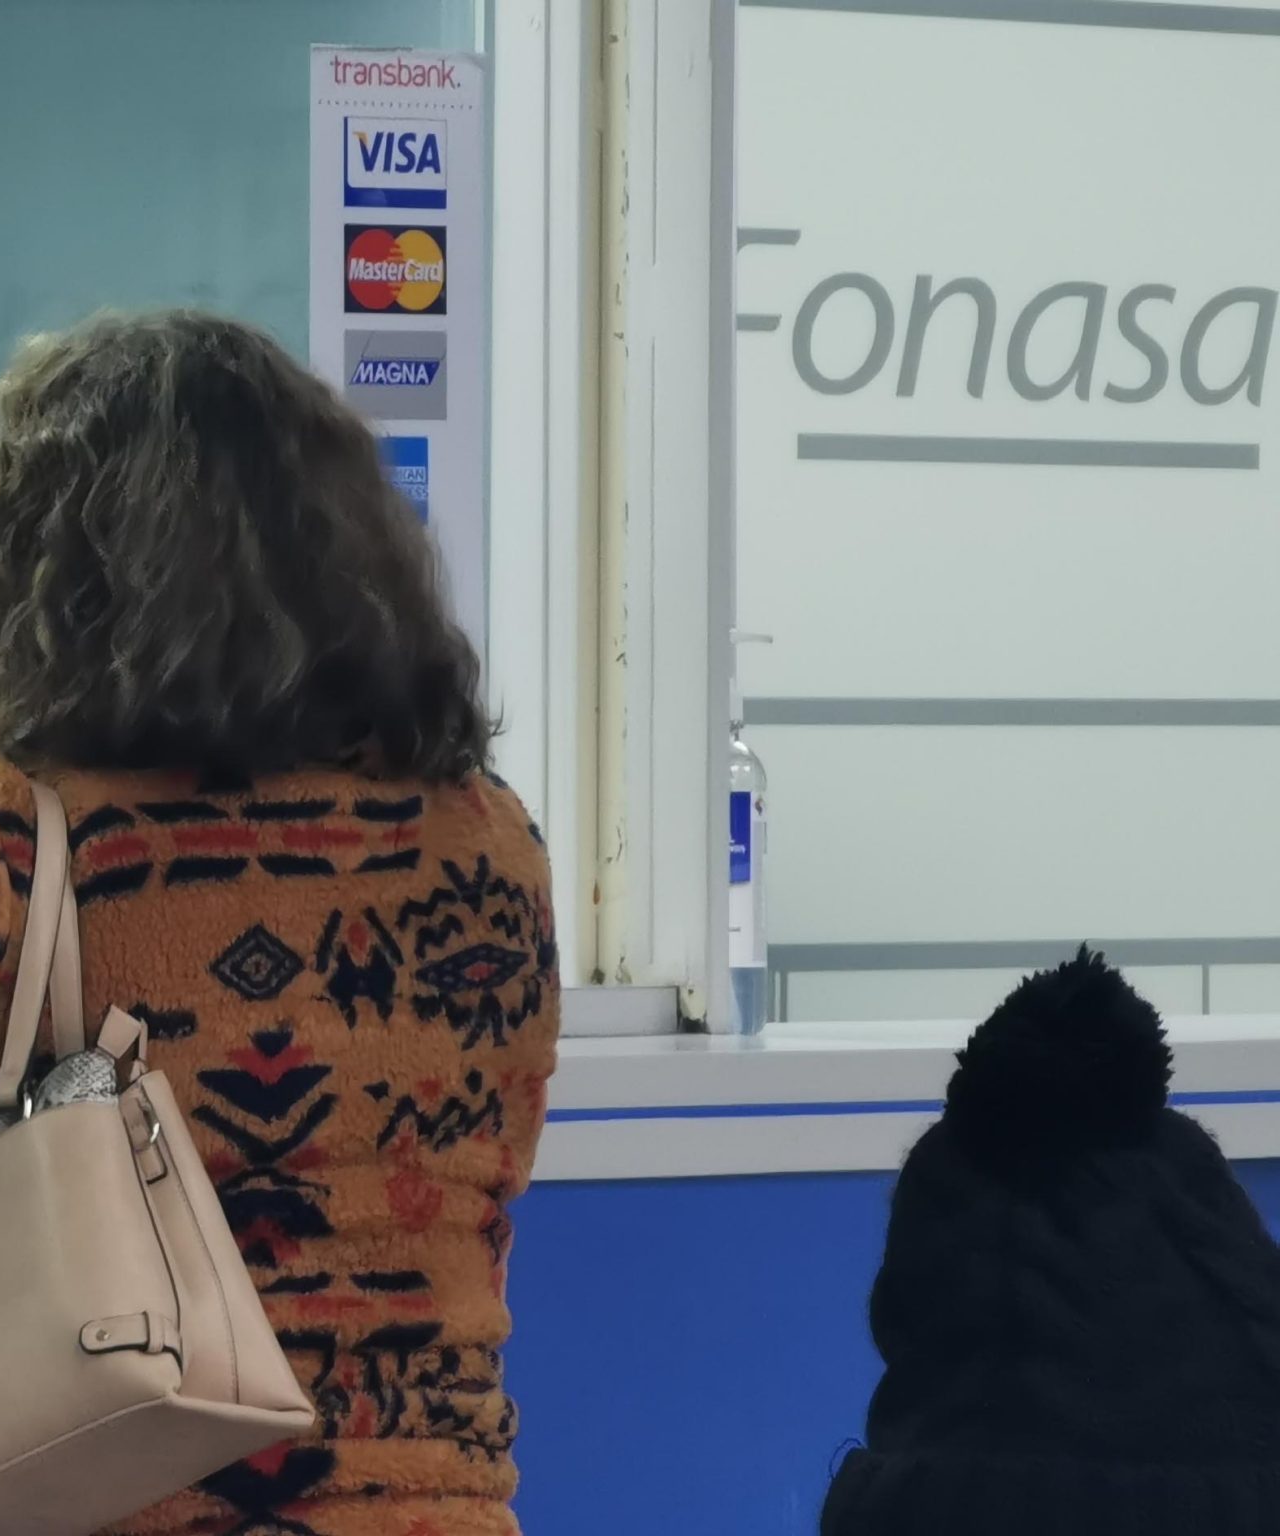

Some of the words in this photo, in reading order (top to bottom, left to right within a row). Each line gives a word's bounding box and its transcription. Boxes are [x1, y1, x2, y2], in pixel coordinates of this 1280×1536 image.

[353, 131, 442, 174] VISA
[349, 257, 444, 282] MasterCard
[352, 361, 430, 385] MAGNA
